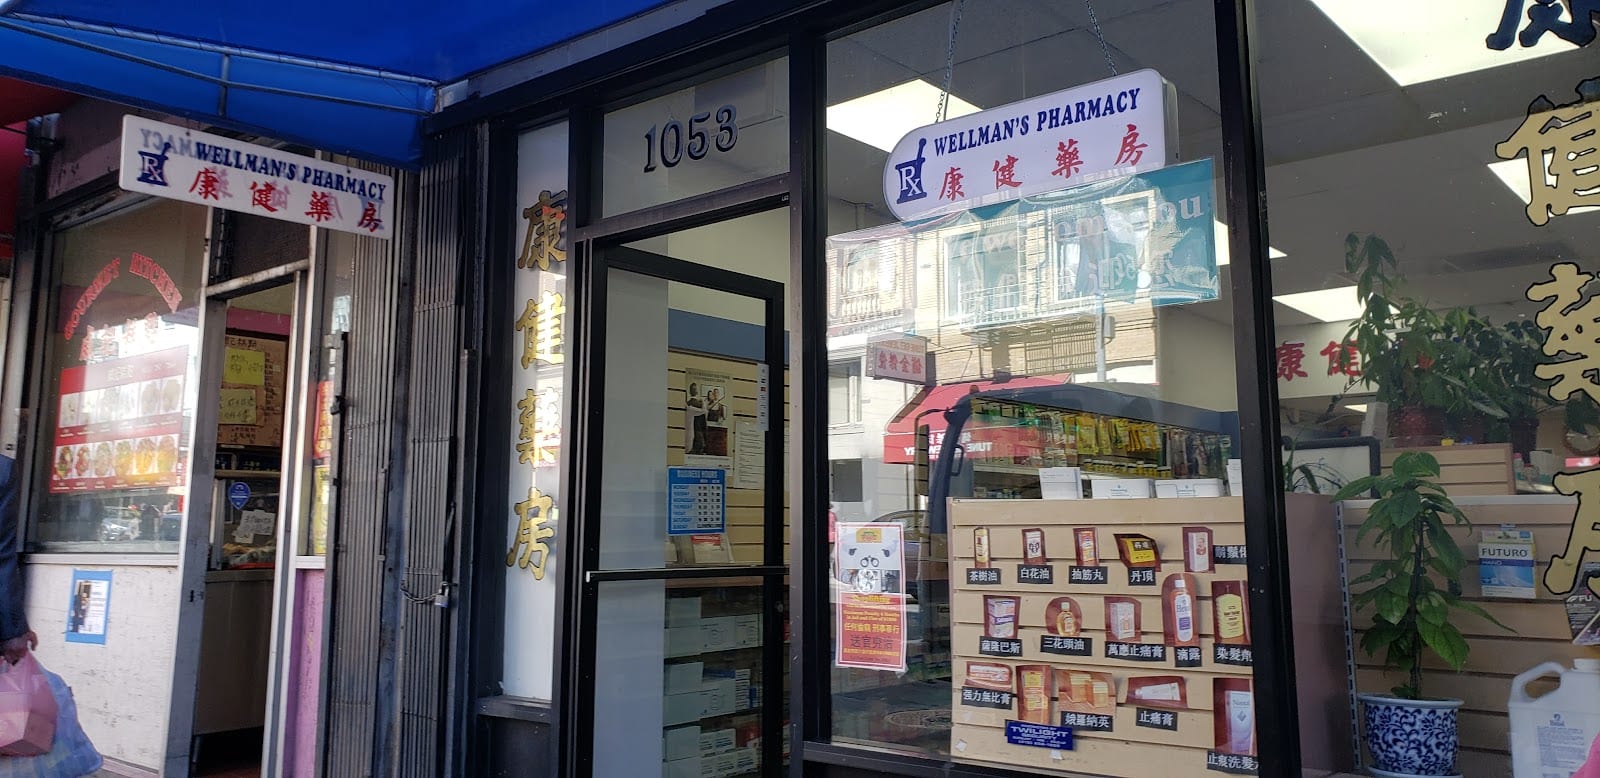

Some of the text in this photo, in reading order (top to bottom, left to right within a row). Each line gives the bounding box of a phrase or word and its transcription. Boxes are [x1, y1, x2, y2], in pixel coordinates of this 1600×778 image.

[643, 103, 739, 173] 1053
[934, 87, 1141, 157] WELLMAN'S PHARMACY
[195, 142, 386, 200] WELLMAN'S PHARMACY
[938, 123, 1149, 201] 康健藥房
[189, 167, 383, 233] 康健藥房
[506, 188, 568, 581] 康健藥房
[1482, 548, 1528, 557] FUTURO
[1020, 568, 1050, 579] 白花油
[1130, 570, 1154, 582] 丹頂
[1043, 637, 1085, 650] 三花頭油
[1010, 726, 1069, 737] TWILIGHT
[1139, 711, 1173, 726] 止痛膏
